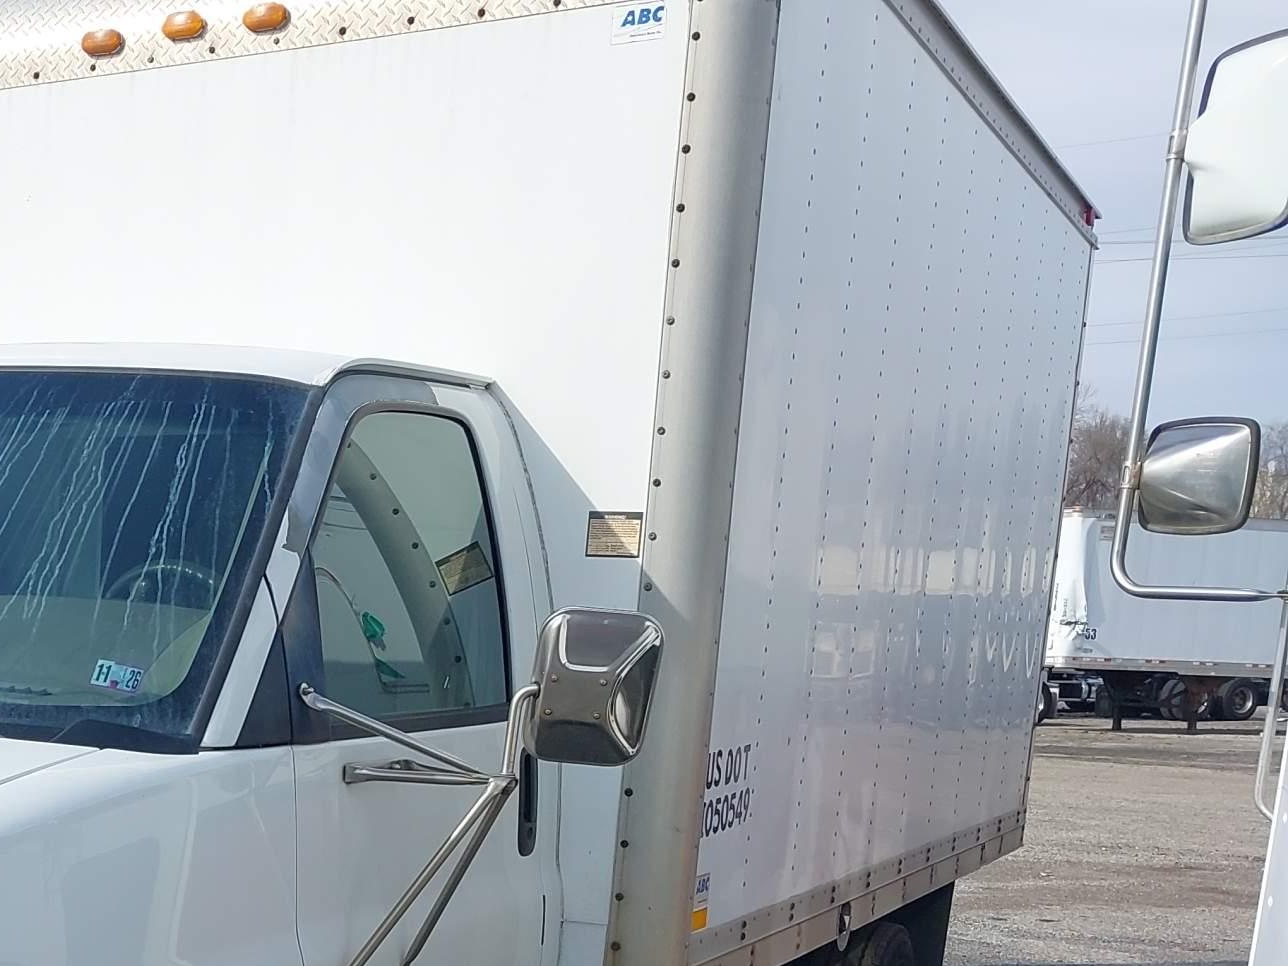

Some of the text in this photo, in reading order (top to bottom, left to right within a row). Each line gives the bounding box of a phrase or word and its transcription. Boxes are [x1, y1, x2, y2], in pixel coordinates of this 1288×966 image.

[620, 5, 664, 27] ABC
[125, 670, 141, 689] 26
[706, 744, 751, 790] US DOT
[701, 787, 750, 838] 050549
